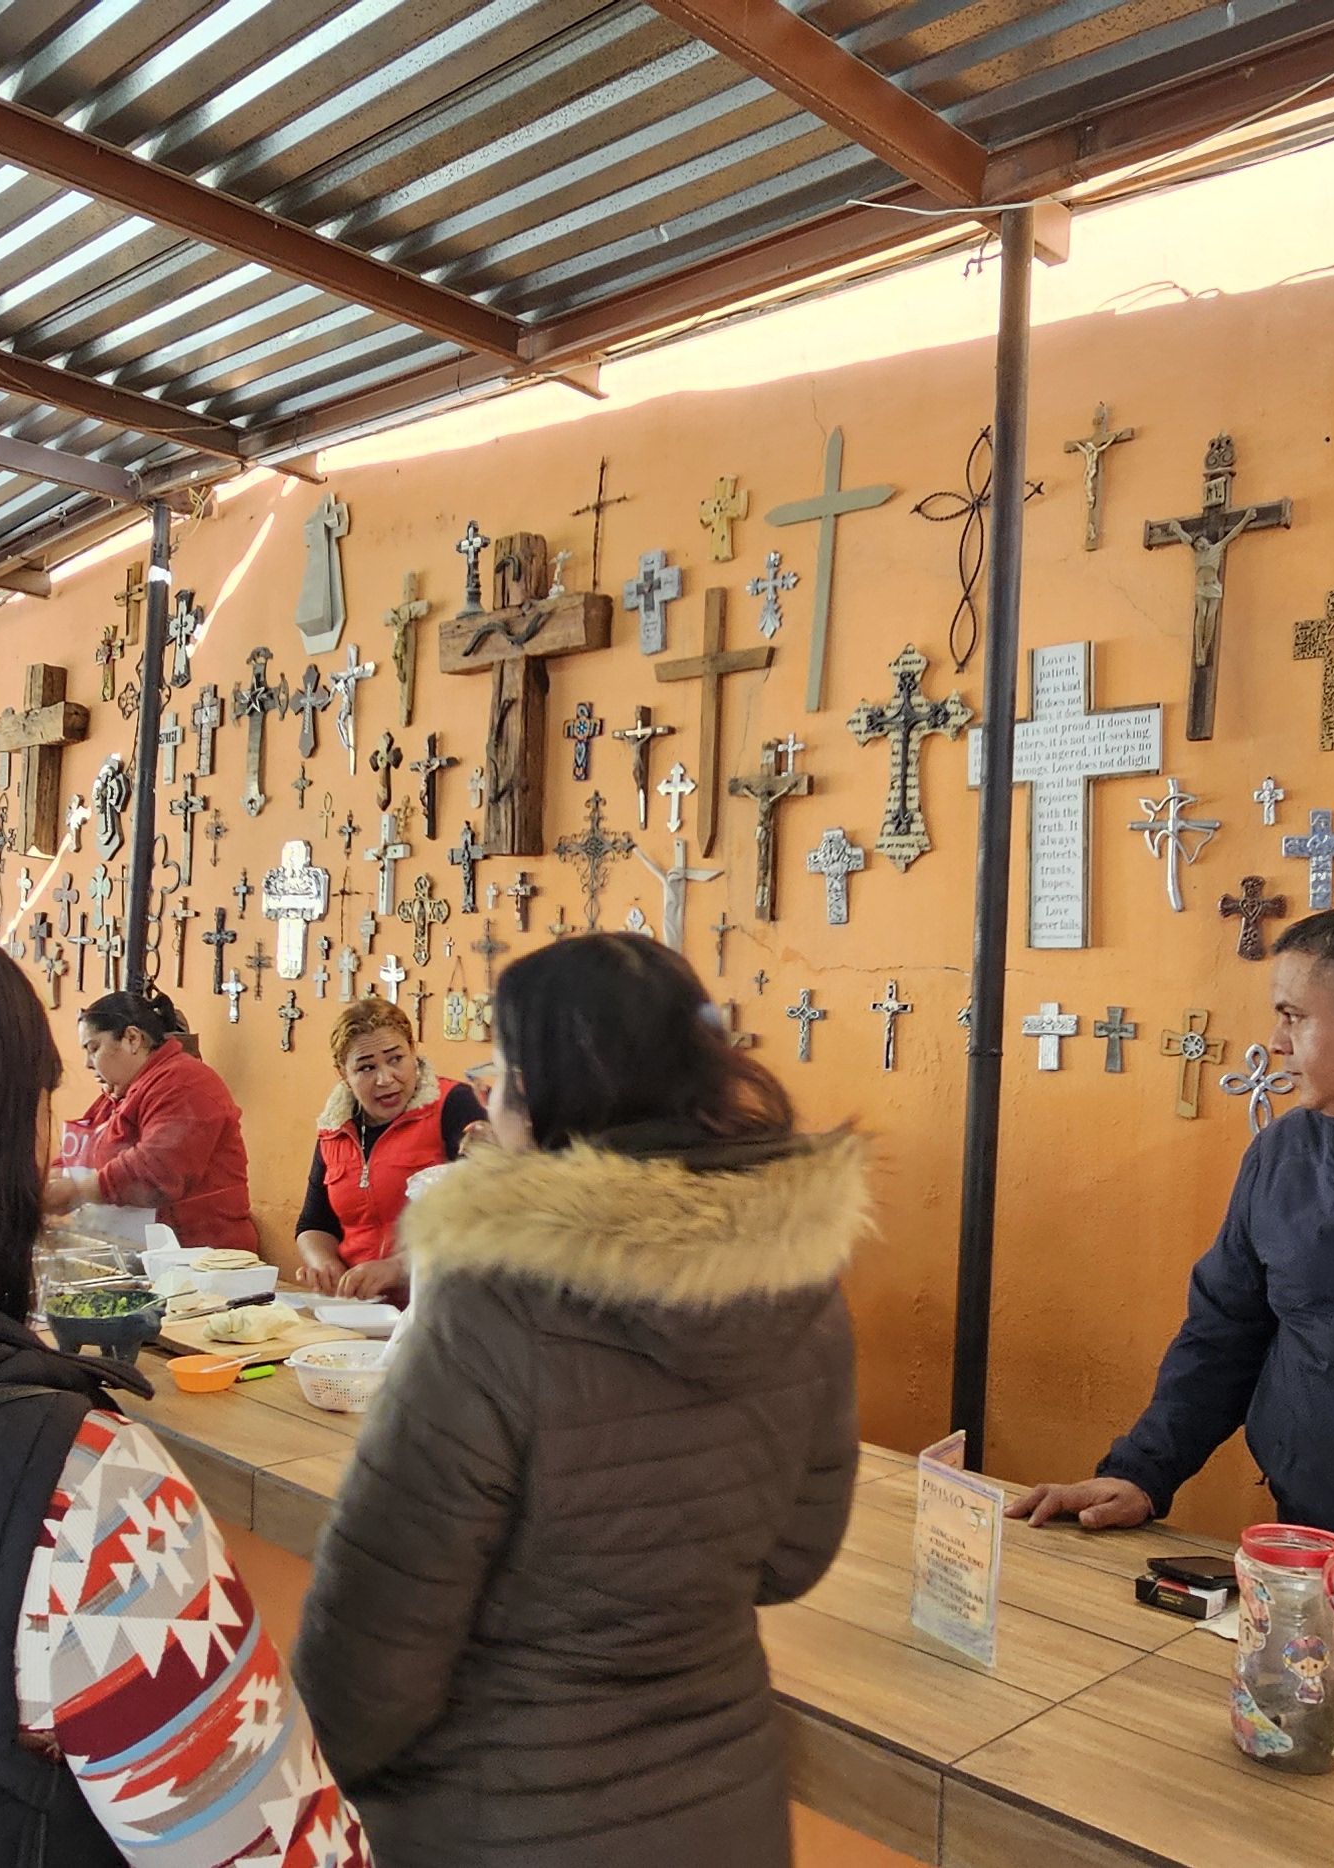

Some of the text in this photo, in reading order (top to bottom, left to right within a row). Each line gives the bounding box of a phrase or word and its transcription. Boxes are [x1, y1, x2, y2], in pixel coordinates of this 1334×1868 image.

[1041, 653, 1077, 667] Love is
[1053, 683, 1061, 693] is
[1035, 695, 1082, 710] It does not
[1022, 727, 1029, 737] it
[1032, 726, 1041, 736] is
[1043, 724, 1059, 735] not
[1097, 718, 1105, 729] It
[1108, 717, 1132, 727] does
[1134, 714, 1151, 725] not
[1050, 737, 1057, 747] it
[1059, 736, 1068, 746] is
[1070, 735, 1085, 745] not
[1094, 745, 1101, 756] it
[1105, 744, 1136, 756] keeps
[1138, 742, 1152, 752] no
[1052, 762, 1076, 774] Love
[1076, 760, 1098, 771] does
[1100, 758, 1115, 769] not
[1117, 755, 1151, 768] delight
[1046, 777, 1064, 788] evil
[1067, 777, 1082, 788] but
[1039, 792, 1078, 806] rejoices
[1038, 806, 1079, 819] with the
[1070, 819, 1078, 832] It
[1040, 835, 1076, 848] always
[1046, 905, 1070, 917] Love
